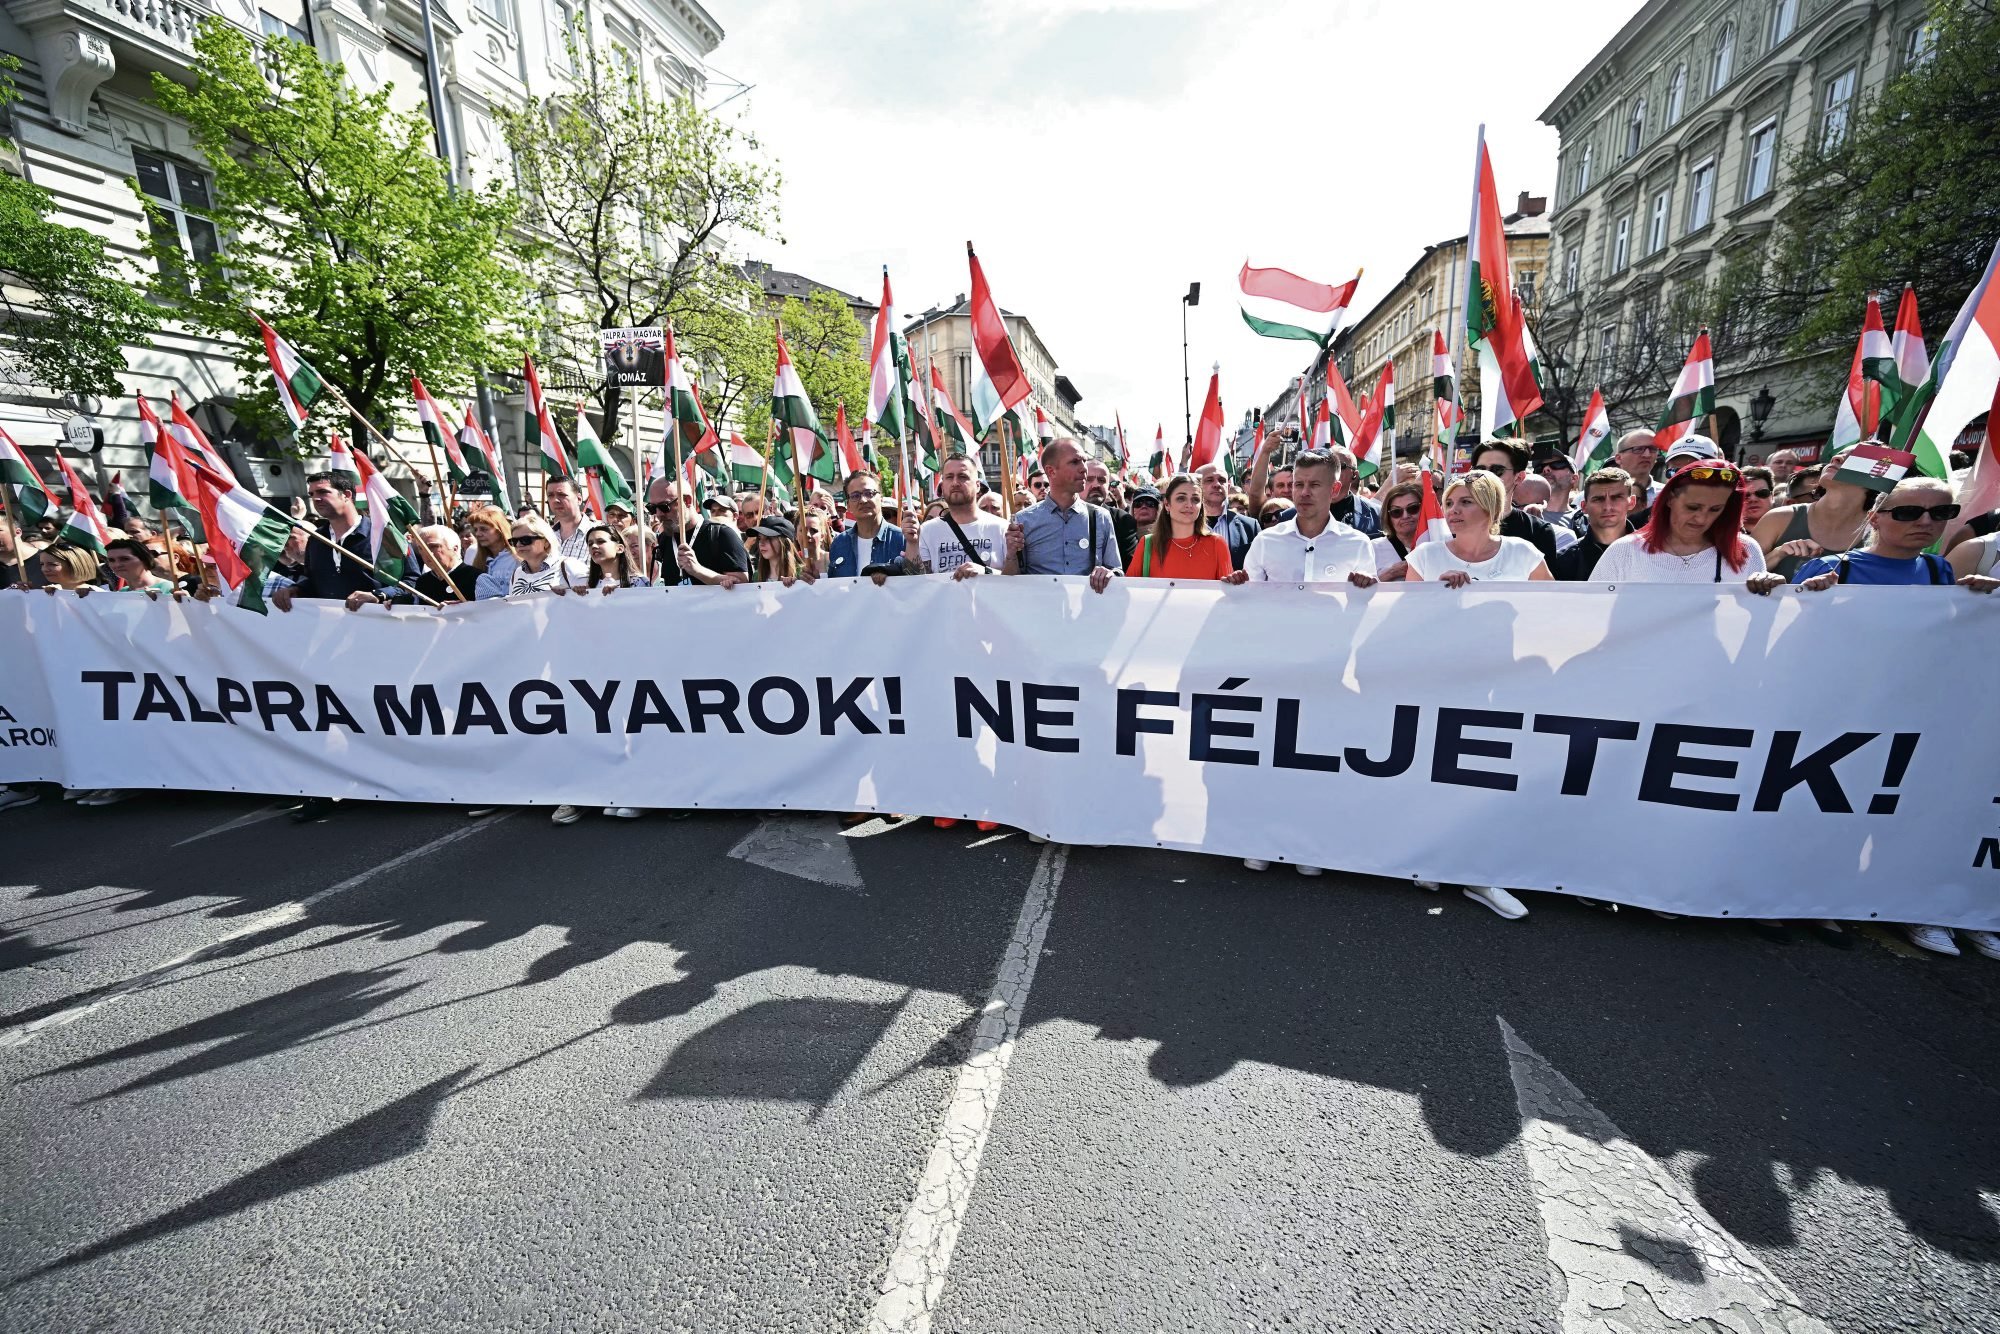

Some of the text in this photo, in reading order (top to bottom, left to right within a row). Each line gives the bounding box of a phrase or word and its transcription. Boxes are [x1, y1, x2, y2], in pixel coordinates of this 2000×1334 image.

[603, 329, 662, 340] TALPRA MAGYAR
[618, 370, 647, 382] POMÁZ
[940, 538, 991, 553] ELECRIC
[81, 671, 1922, 815] TALPRA MAGYAROK! NE FÉLJETEK!
